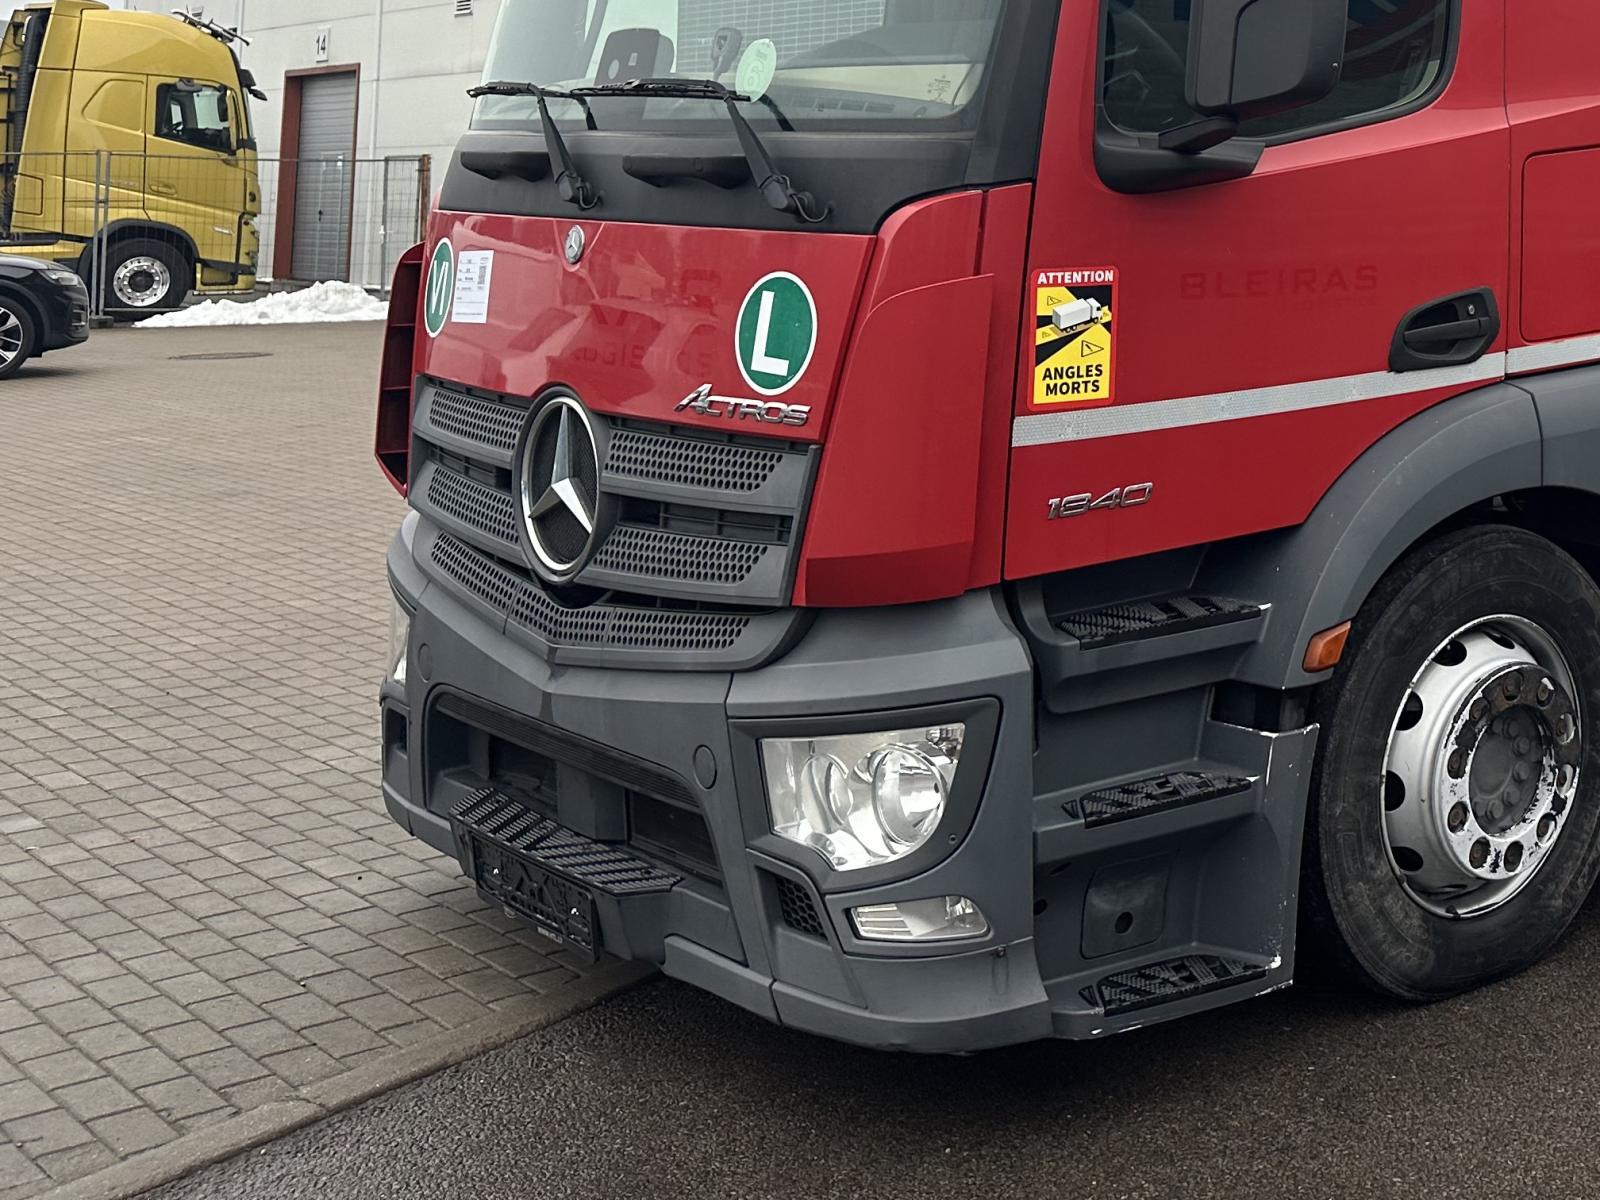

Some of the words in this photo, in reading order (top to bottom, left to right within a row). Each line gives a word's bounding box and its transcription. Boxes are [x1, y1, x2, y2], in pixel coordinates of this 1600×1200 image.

[315, 34, 327, 55] 14
[1037, 269, 1114, 285] ATTENTION
[1180, 265, 1378, 300] BLEIRAS
[751, 290, 790, 377] L
[1042, 364, 1103, 382] ANGLES
[1045, 379, 1100, 397] MORTS
[1047, 482, 1154, 520] 1840
